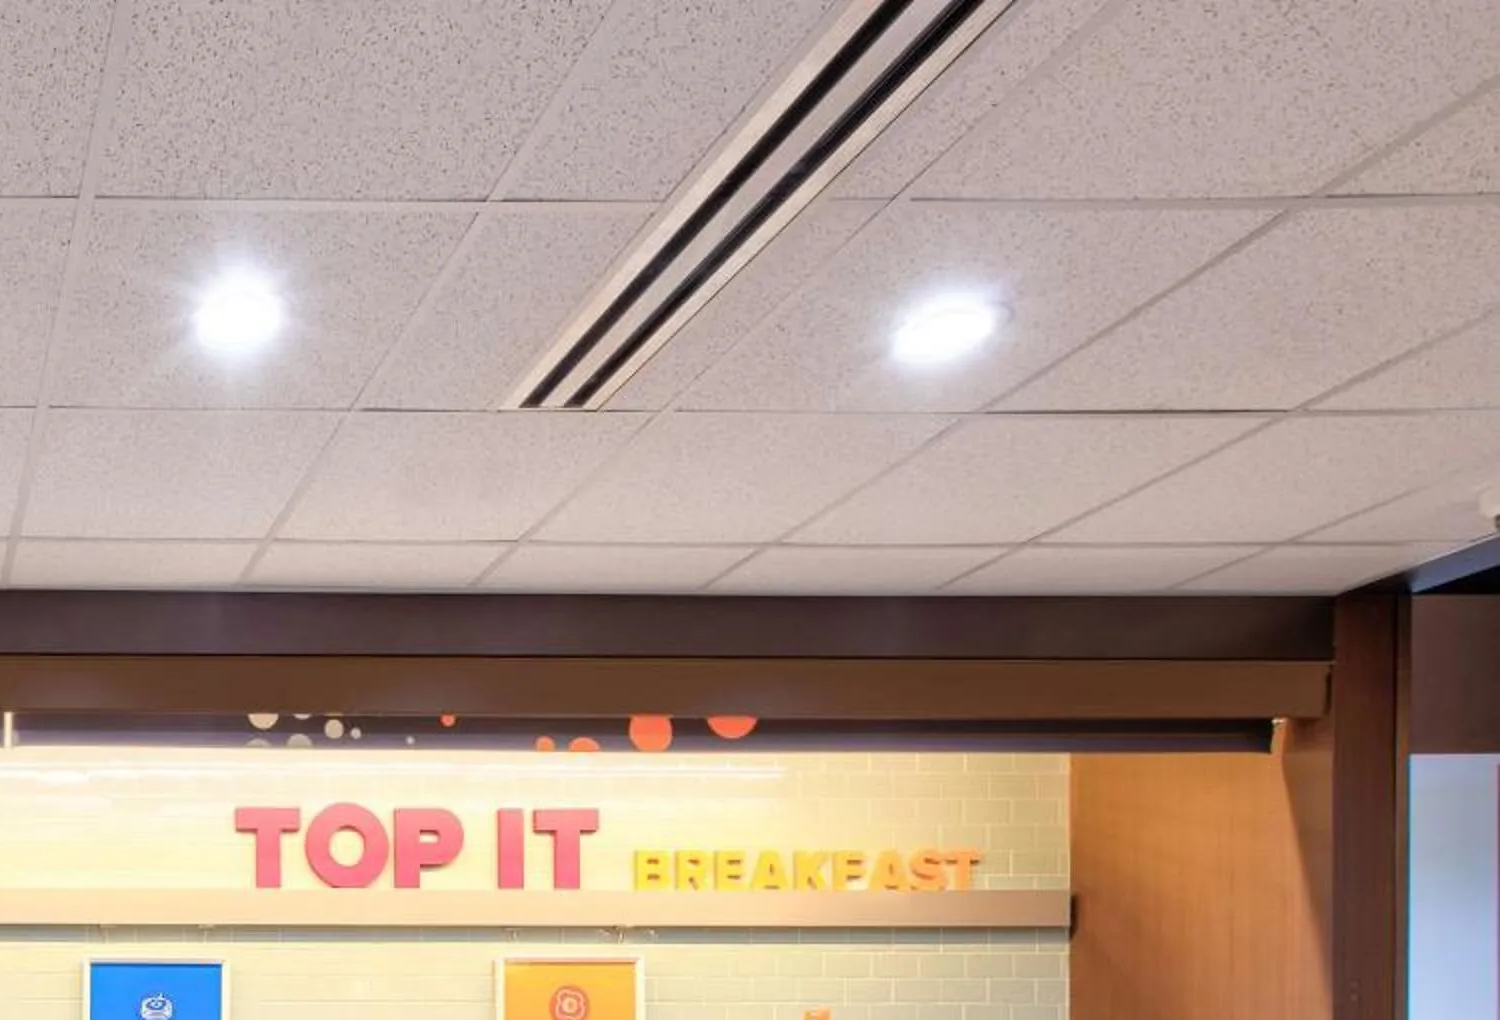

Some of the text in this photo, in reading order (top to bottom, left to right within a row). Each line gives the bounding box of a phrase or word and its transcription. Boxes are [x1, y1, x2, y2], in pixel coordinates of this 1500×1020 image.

[235, 802, 599, 890] TOP IT
[634, 849, 980, 892] BREAKFAST
